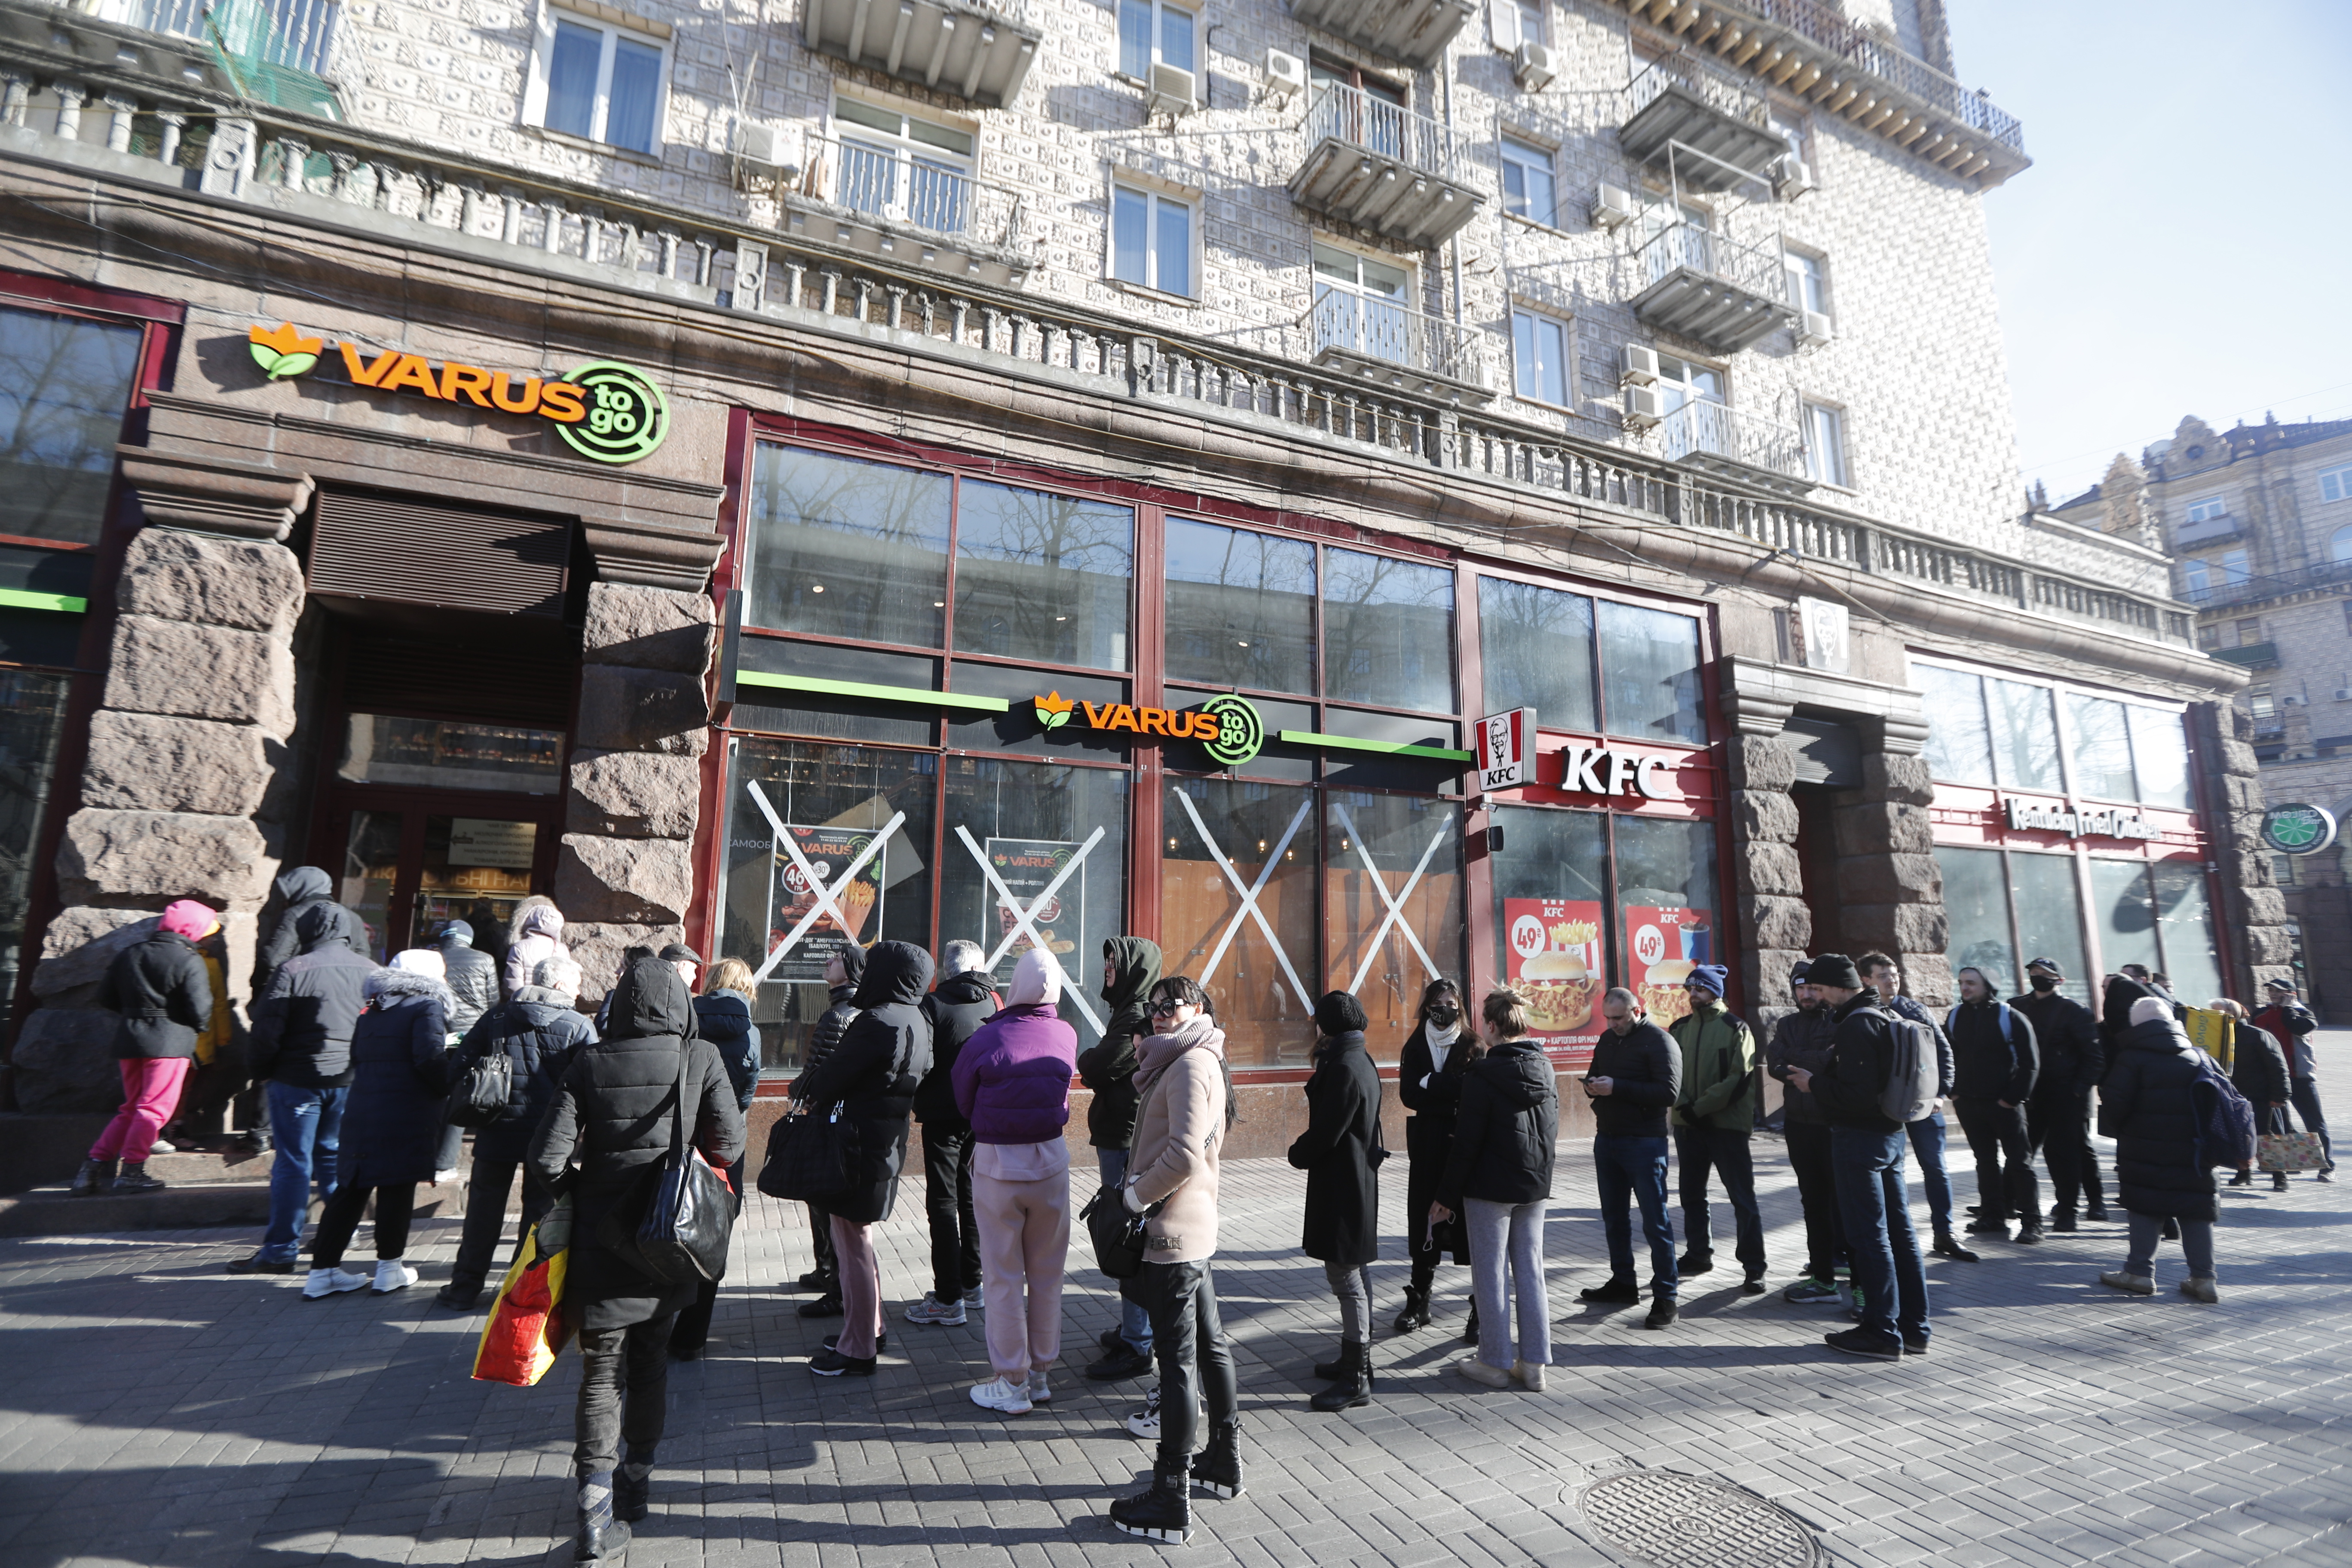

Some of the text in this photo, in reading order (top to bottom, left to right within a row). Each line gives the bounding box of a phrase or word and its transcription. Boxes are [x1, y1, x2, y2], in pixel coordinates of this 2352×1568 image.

[338, 341, 587, 423] VARUS
[594, 384, 634, 413] to
[589, 407, 637, 435] go
[1081, 701, 1219, 740] VARUS
[1222, 711, 1243, 729] to
[1220, 728, 1245, 747] go
[1486, 766, 1516, 786] KFC
[1562, 745, 1670, 799] KFC
[2009, 798, 2161, 839] Kentucky Fried Chicken
[2268, 810, 2318, 820] MOJITO
[801, 842, 853, 855] VARUS
[1009, 856, 1057, 868] VARUS
[786, 869, 805, 885] 46
[1544, 907, 1564, 917] KFC
[1660, 914, 1679, 924] KFC
[1551, 1036, 1577, 1045] КАРТОПЛЯ
